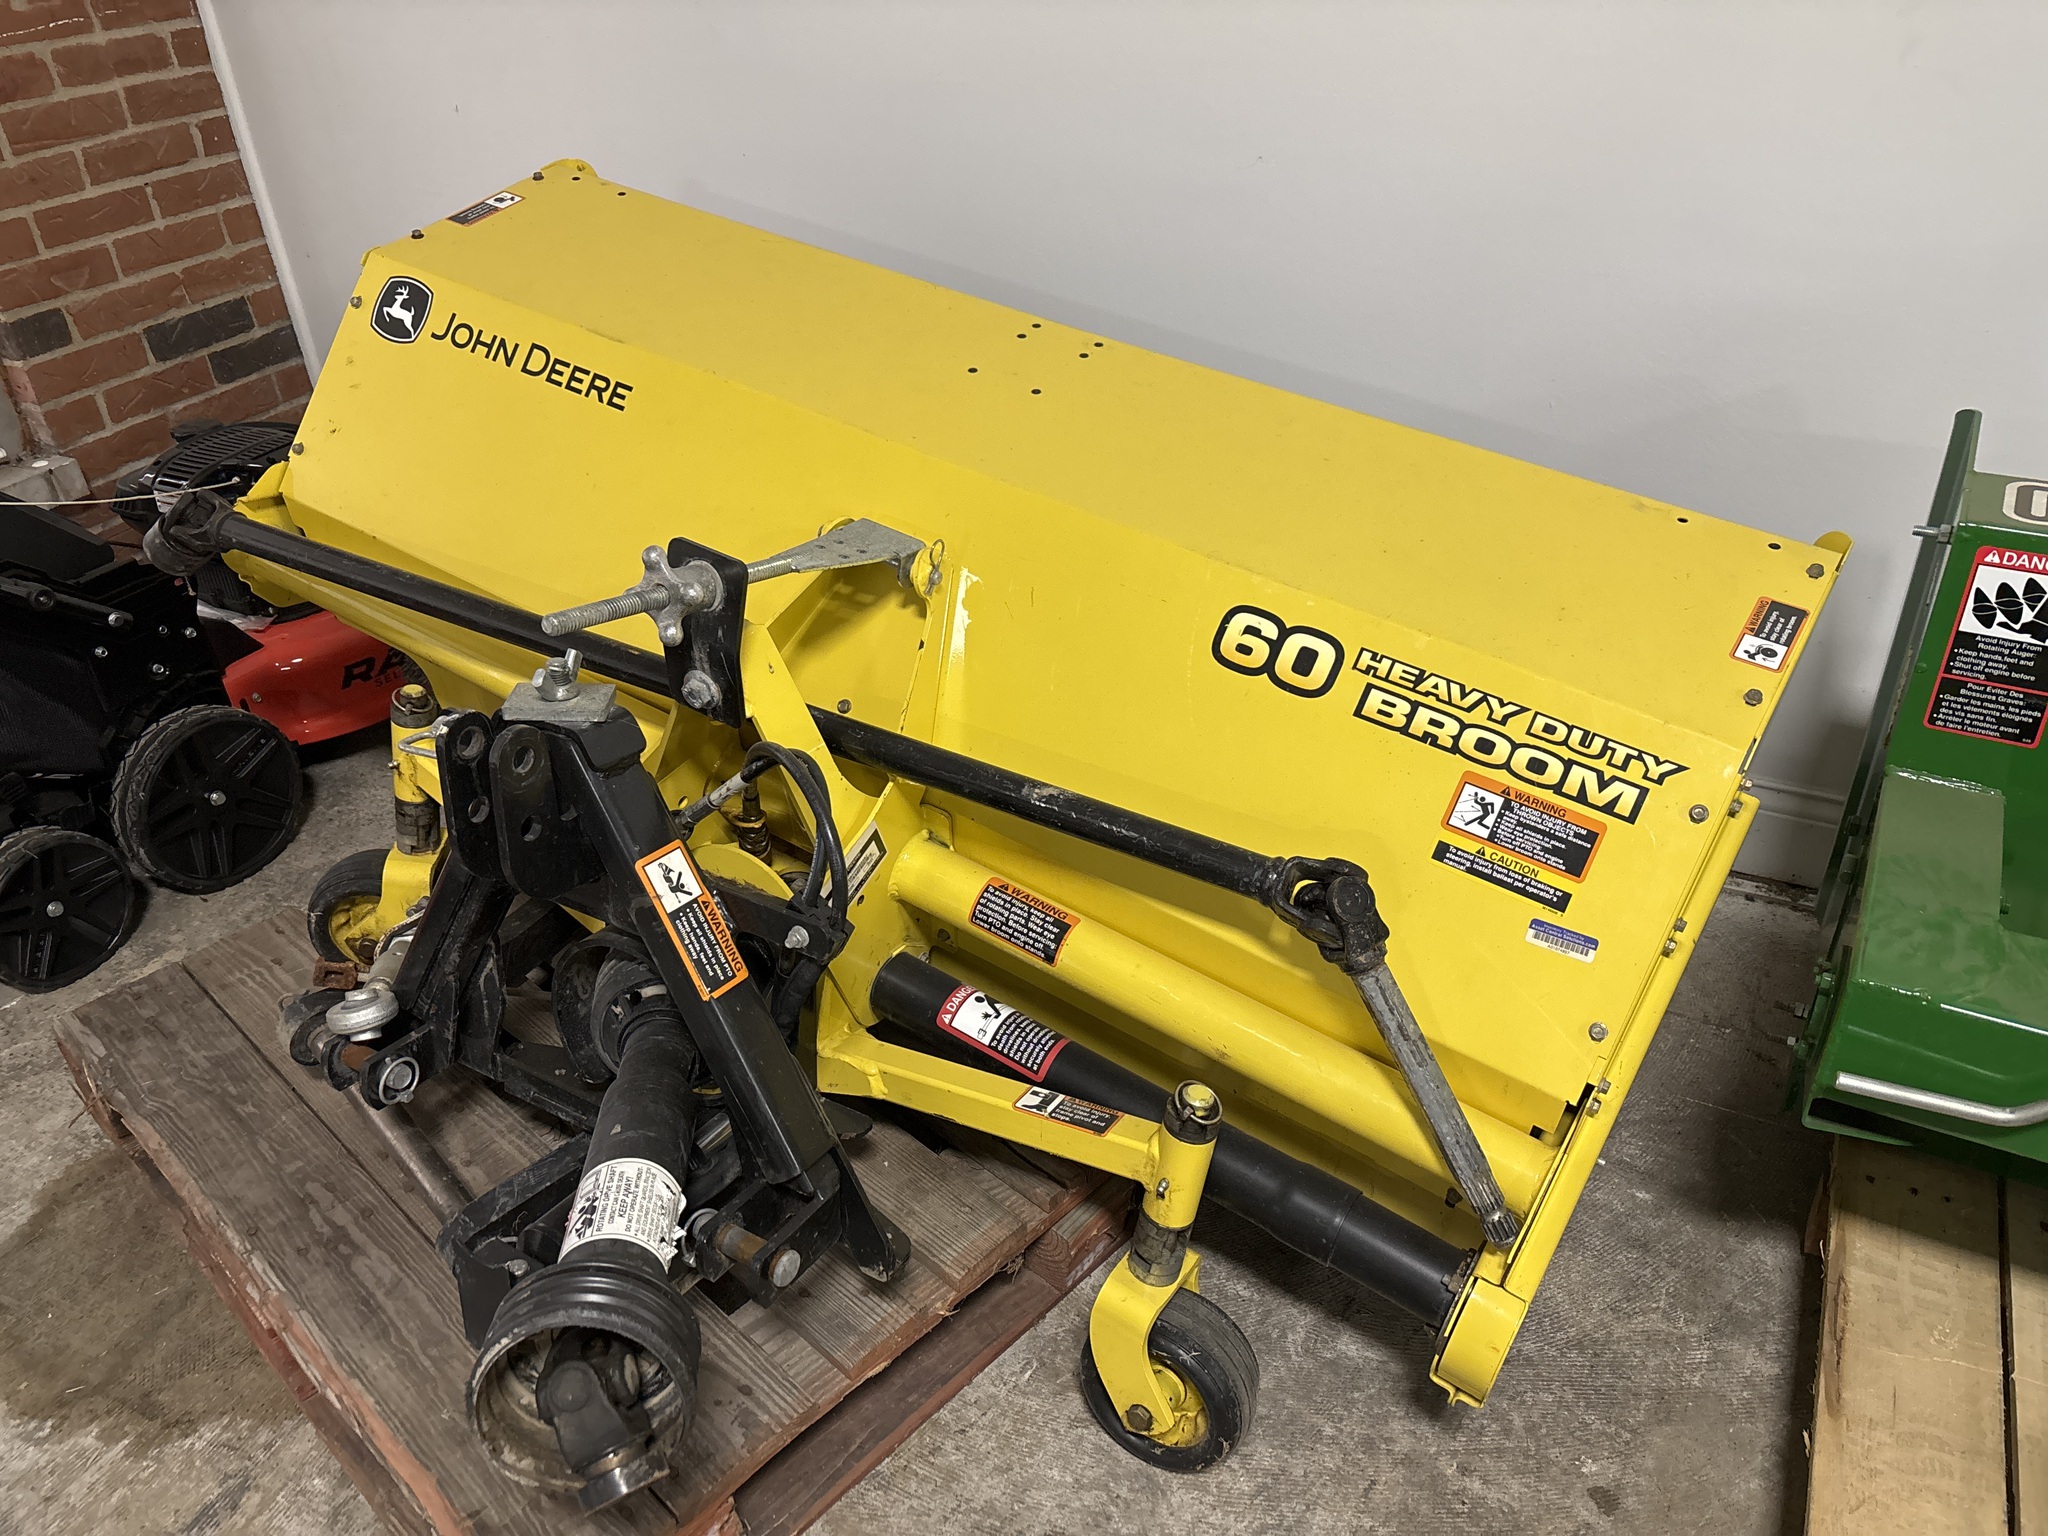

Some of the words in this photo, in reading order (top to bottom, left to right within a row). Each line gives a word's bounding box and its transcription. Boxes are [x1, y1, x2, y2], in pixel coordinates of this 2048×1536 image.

[431, 312, 518, 367] JOHN
[521, 343, 633, 411] DEERE
[2002, 551, 2048, 571] DAN
[1212, 604, 1344, 698] 60
[1352, 647, 1530, 726] HEAVY
[1526, 711, 1690, 786] DUTY
[1352, 684, 1648, 825] BROOM
[1515, 791, 1567, 818] WARNING
[1490, 852, 1539, 878] CAUTION
[983, 892, 1004, 905] shields
[1030, 915, 1044, 926] Stay
[1044, 923, 1060, 933] clear
[987, 902, 1009, 917] rotating
[1009, 914, 1025, 925] parts.
[1028, 922, 1043, 933] Wear
[1044, 931, 1055, 939] eye
[995, 891, 1012, 901] avoid
[1030, 908, 1045, 918] keep
[1012, 888, 1068, 920] WARNING
[676, 920, 690, 944] clothing
[688, 944, 698, 959] away
[681, 917, 691, 932] Keep
[700, 952, 708, 964] feet
[705, 965, 714, 976] and
[688, 913, 698, 928] Keep
[700, 937, 712, 957] shields
[714, 964, 724, 980] place
[693, 904, 705, 922] AVOID
[703, 923, 716, 944] INJURY
[714, 945, 726, 963] FROM
[724, 963, 732, 976] PTO
[708, 909, 743, 972] WARNING
[973, 917, 990, 929] Lower
[991, 926, 1010, 939] broom
[1011, 937, 1024, 947] onto
[1025, 945, 1046, 957] stands.
[975, 910, 987, 920] Turn
[988, 917, 1001, 927] PTO
[1002, 925, 1013, 934] and
[1014, 932, 1033, 944] engine
[1034, 942, 1046, 950] off.
[976, 905, 1006, 923] protection.
[1008, 920, 1028, 933] Before
[1029, 931, 1057, 949] servicing:
[946, 986, 974, 1014] DANGE
[604, 1185, 613, 1201] DRVE
